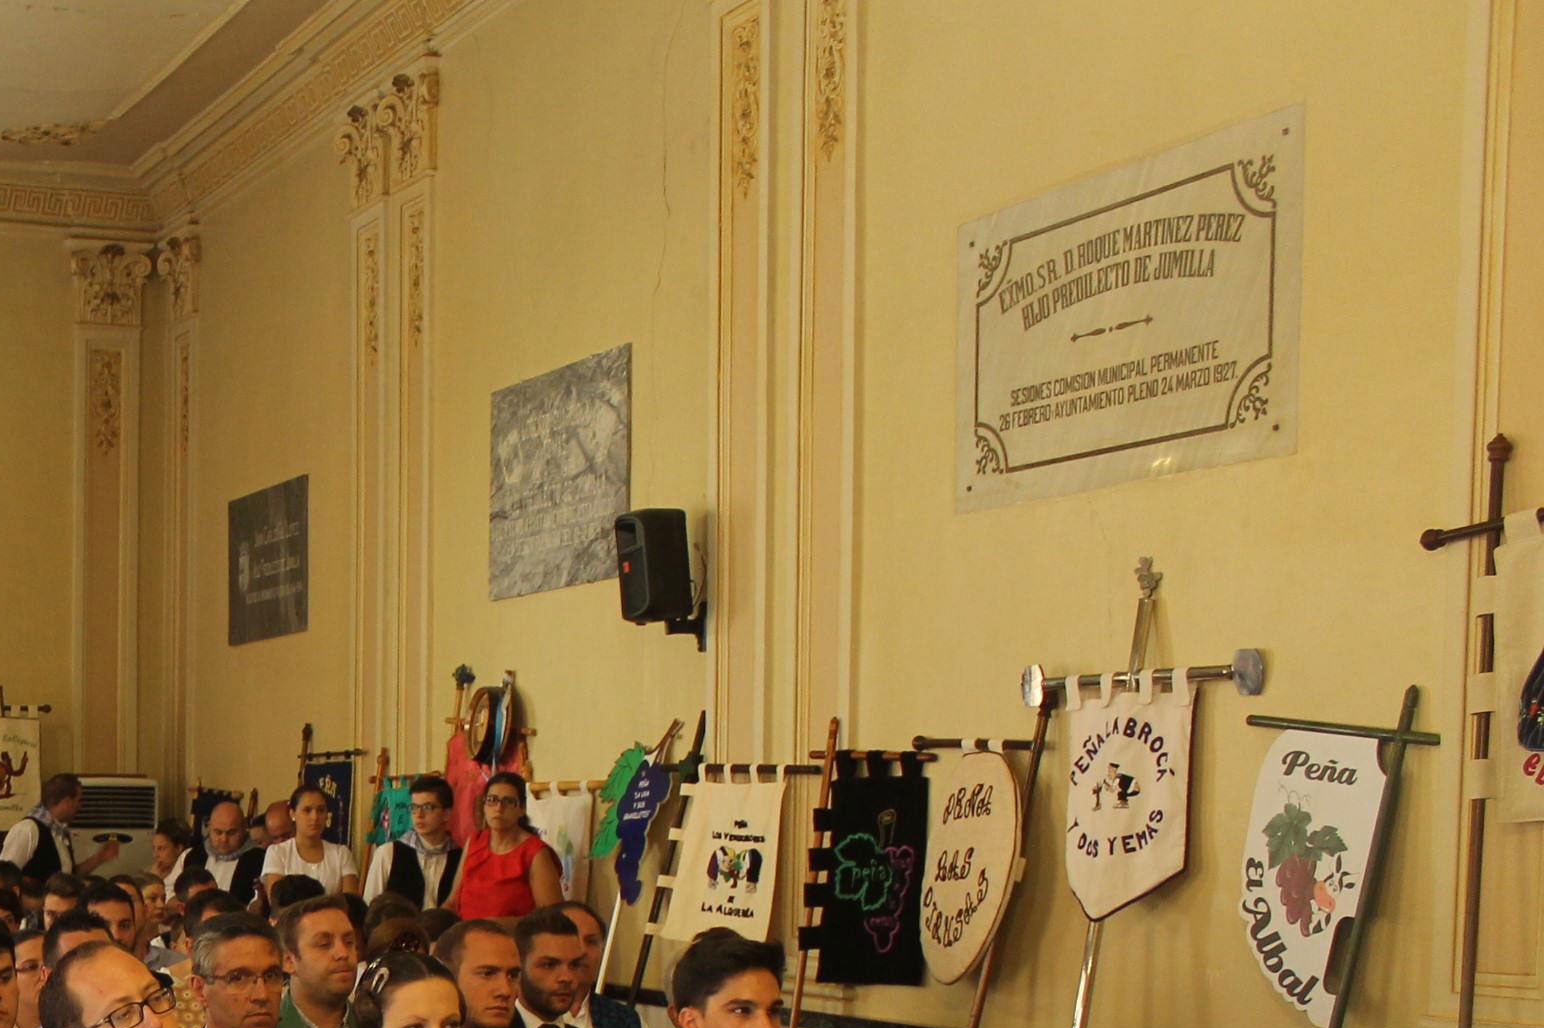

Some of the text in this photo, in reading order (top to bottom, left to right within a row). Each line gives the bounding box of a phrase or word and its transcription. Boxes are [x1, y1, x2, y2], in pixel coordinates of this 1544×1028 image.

[1037, 258, 1062, 289] SR.
[1063, 249, 1076, 275] D.
[1077, 229, 1121, 269] ROQUE
[1122, 215, 1194, 253] MARTINEZ
[1195, 213, 1246, 242] PEREZ
[1021, 248, 1216, 331] HIJO PREDILECTO DE JUMILLA
[999, 414, 1010, 432] 26
[1055, 388, 1124, 419] AYUNTAMIENTO
[1127, 379, 1159, 404] PLENO
[1160, 377, 1174, 396] 24
[1175, 367, 1210, 391] MARZO
[1010, 340, 1220, 407] SESIONES COMISION MUNICIPAL PERMANENTE
[1069, 734, 1105, 787] PEÑA
[1106, 716, 1119, 739] LA
[1281, 750, 1358, 787] Peña
[1067, 817, 1080, 833] Y
[1107, 809, 1164, 856] YEMAS
[701, 902, 713, 913] LA
[1242, 896, 1320, 1006] Albal
